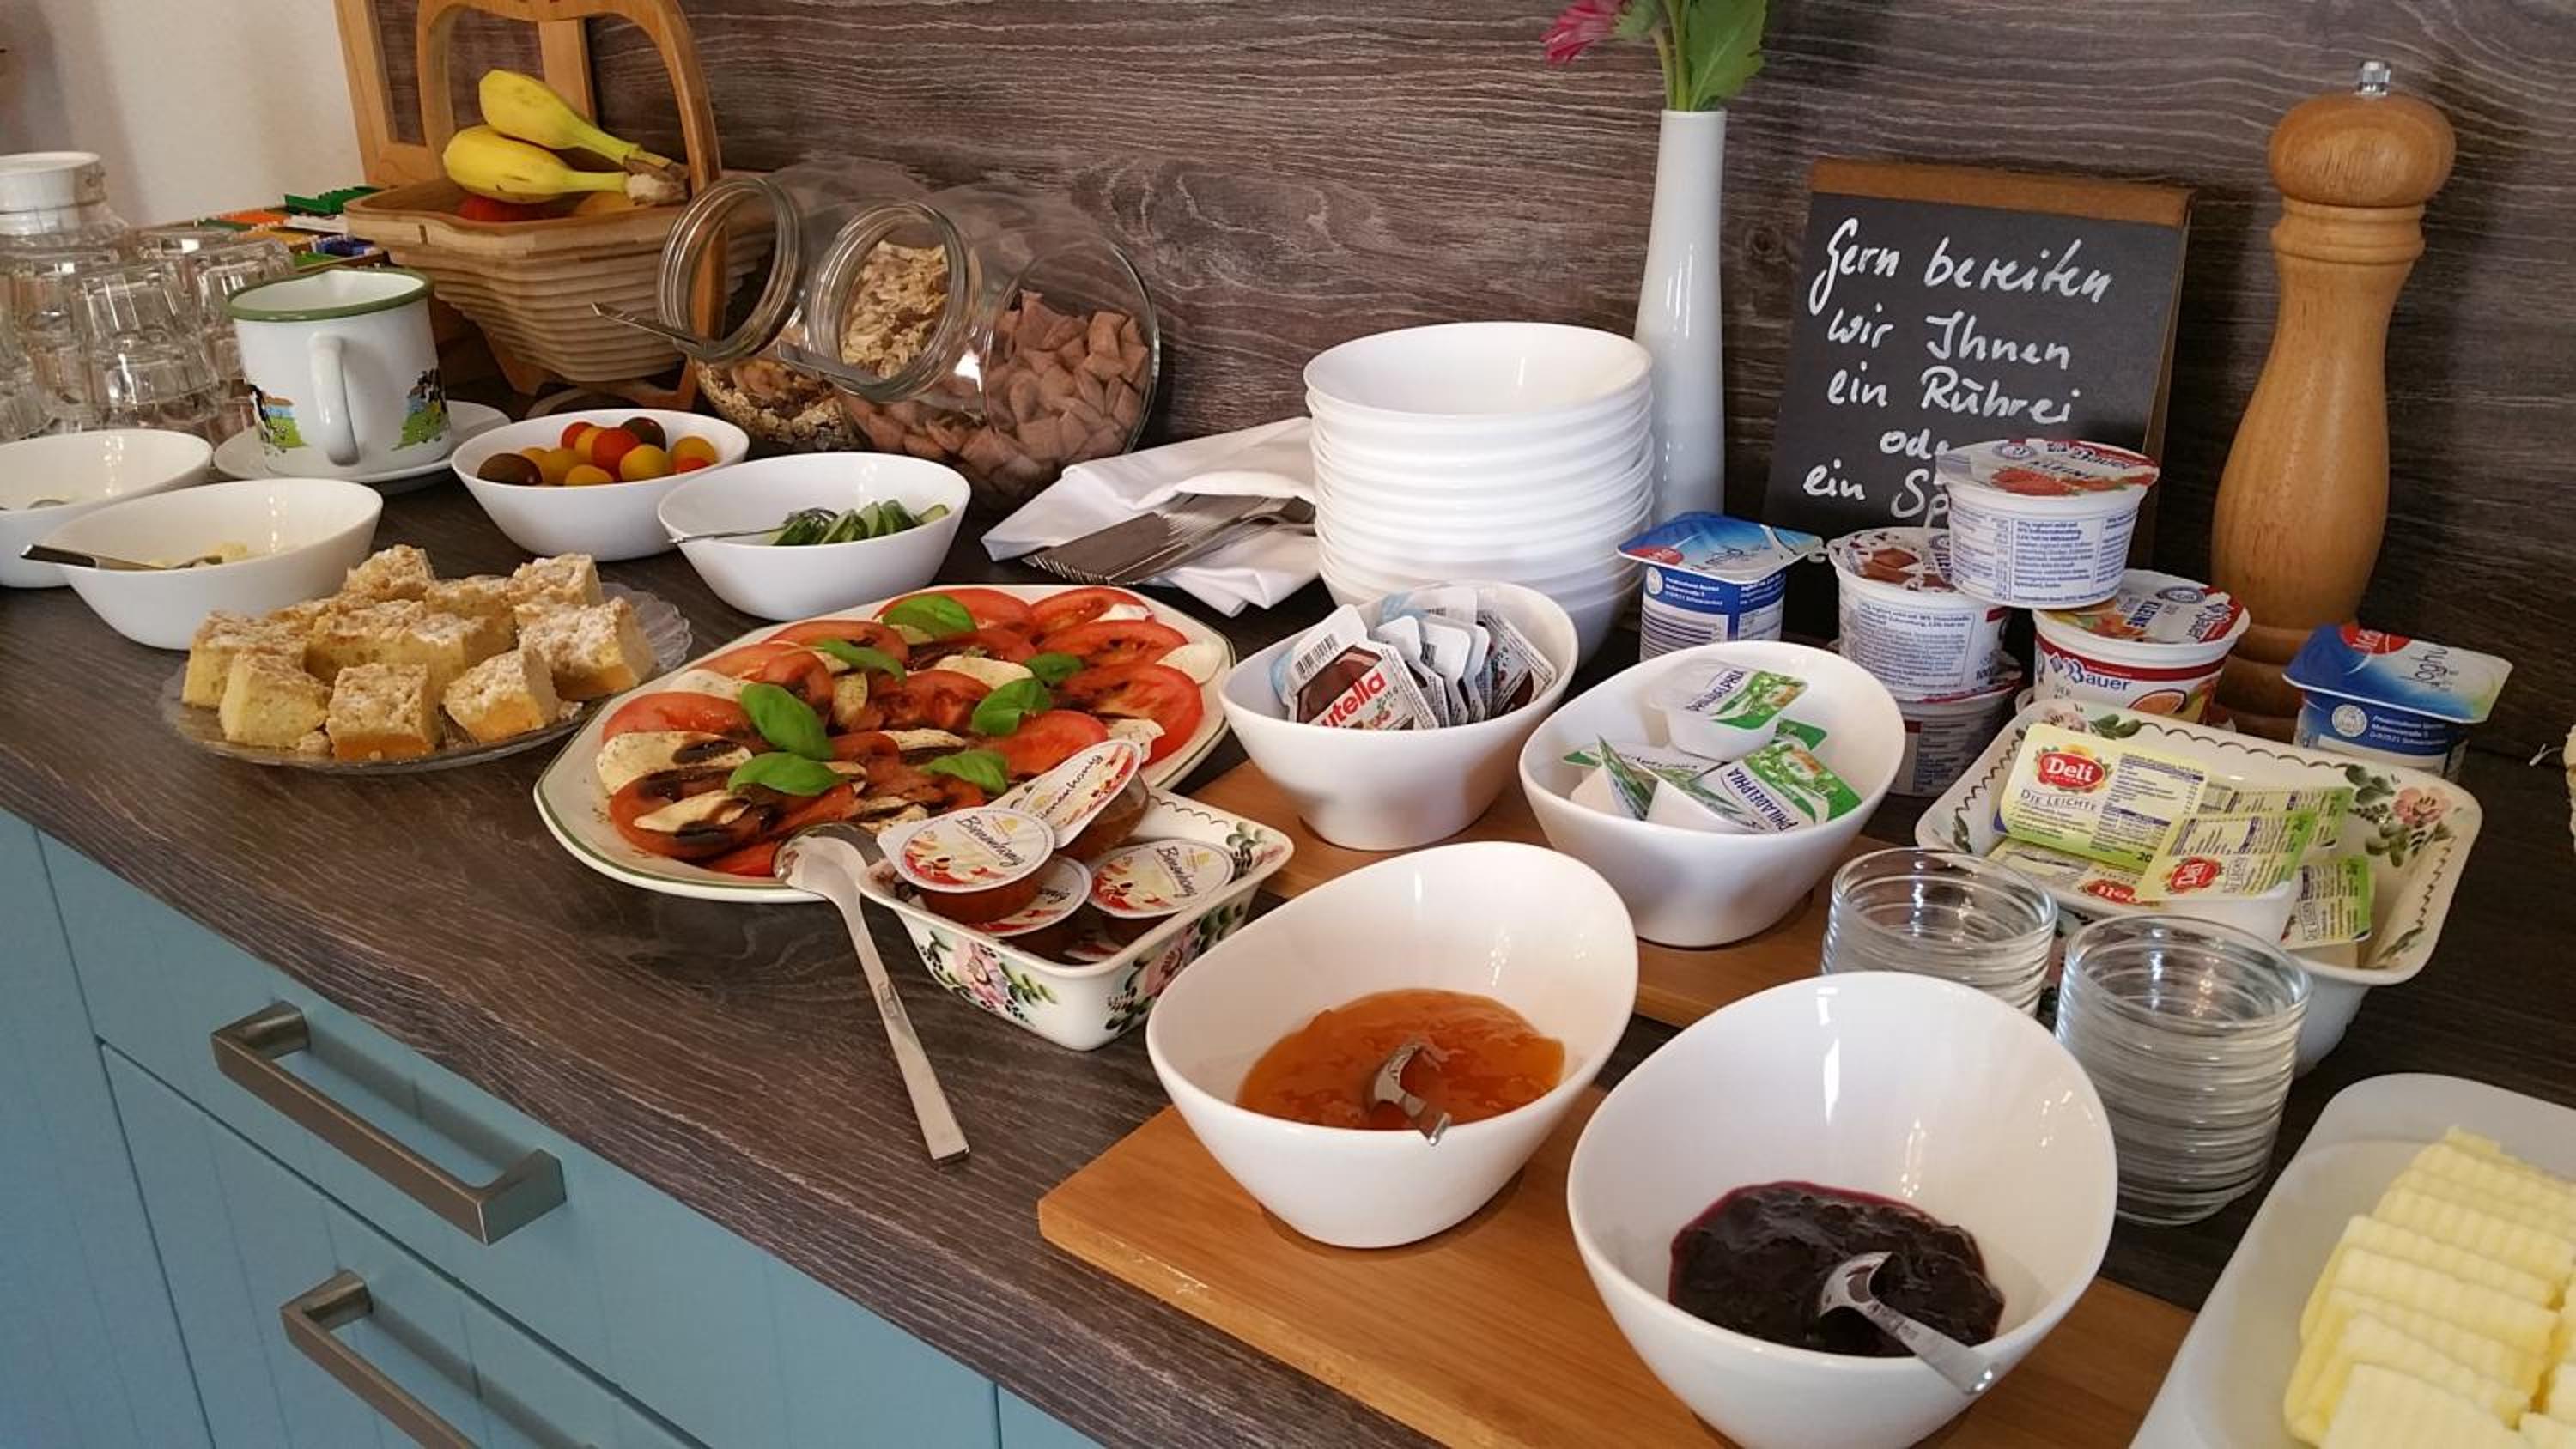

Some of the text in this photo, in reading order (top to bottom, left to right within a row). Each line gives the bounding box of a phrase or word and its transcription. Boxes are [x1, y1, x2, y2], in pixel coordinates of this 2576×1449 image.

[1808, 217, 2112, 317] Gern bereiten
[1827, 303, 2070, 371] wir Ihnen
[1827, 361, 2081, 425] ein Rührei
[1879, 429, 1950, 459] ode
[1802, 458, 1867, 501] ein
[2065, 658, 2131, 692] Bauer
[2045, 757, 2093, 783] Deli
[1729, 766, 1800, 833] PHILADELPHIA
